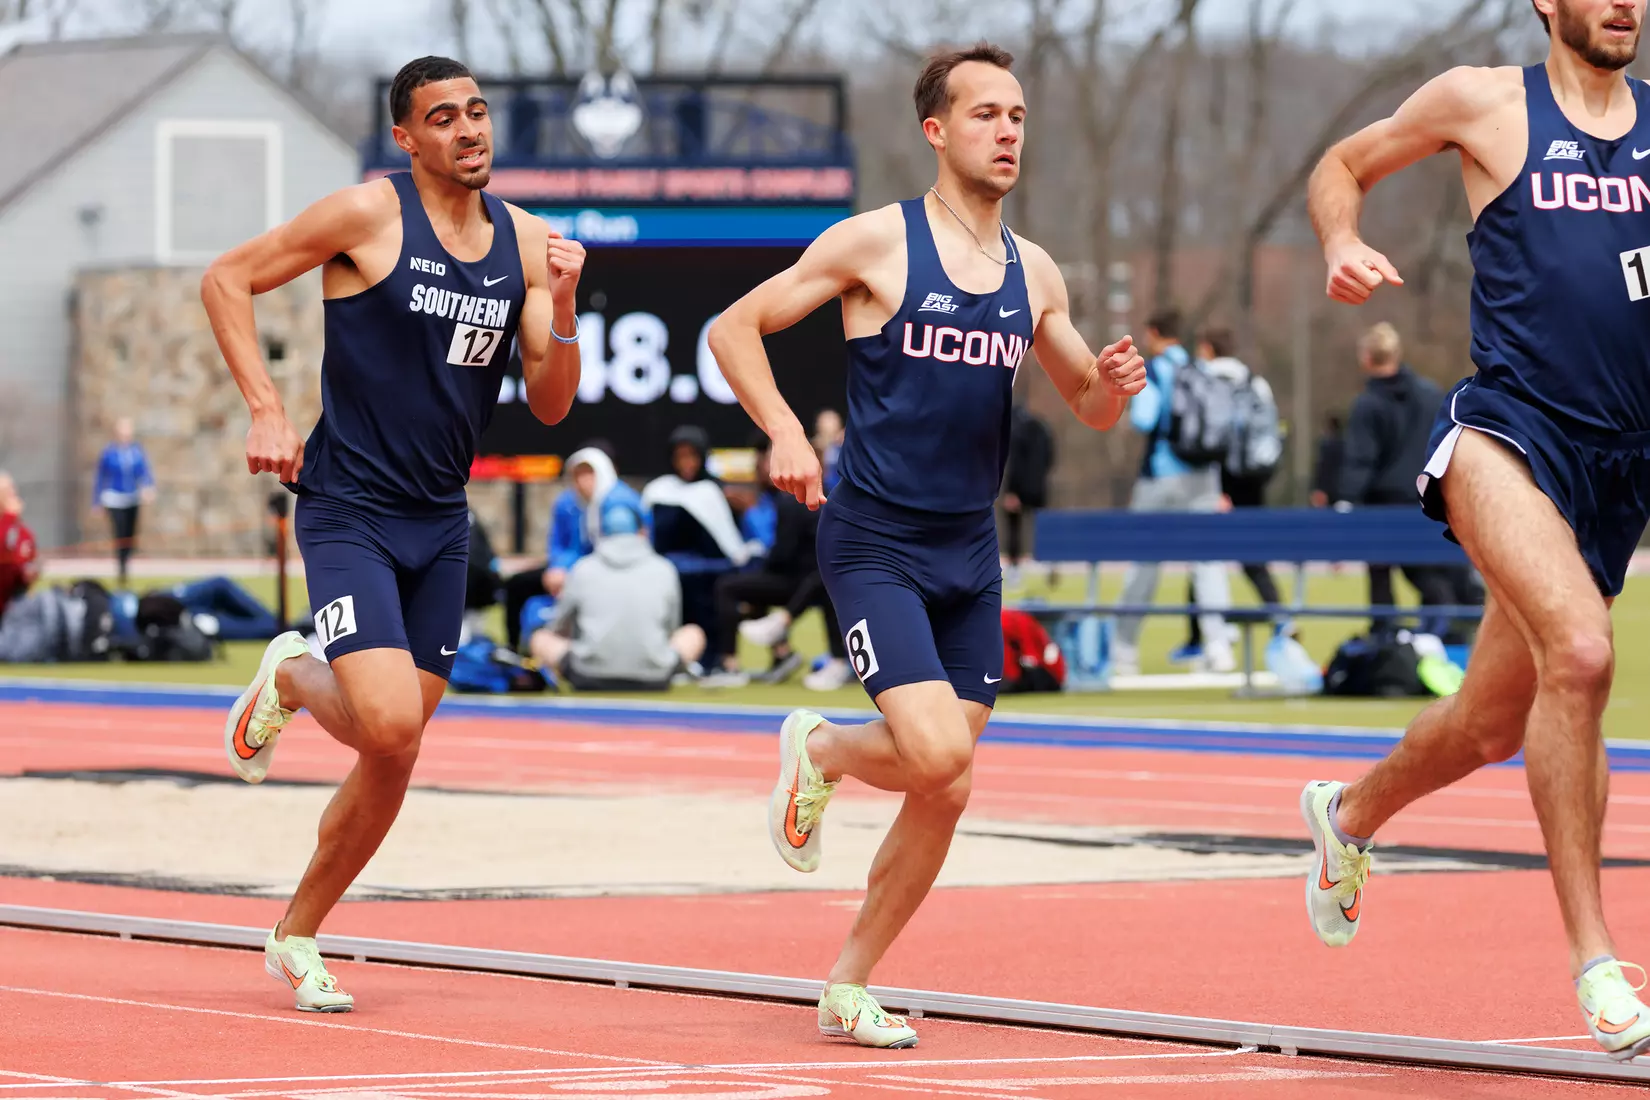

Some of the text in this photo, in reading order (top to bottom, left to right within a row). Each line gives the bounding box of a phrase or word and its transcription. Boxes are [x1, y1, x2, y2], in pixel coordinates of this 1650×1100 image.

[1546, 149, 1586, 159] EAST
[1550, 140, 1579, 149] BIG
[409, 256, 446, 277] NE10
[409, 283, 511, 328] SOUTHERN
[920, 300, 959, 312] EAST
[925, 292, 954, 304] BIG
[462, 329, 495, 364] 12
[902, 322, 1029, 369] UCONN
[320, 601, 347, 642] 12
[849, 629, 871, 678] 8
